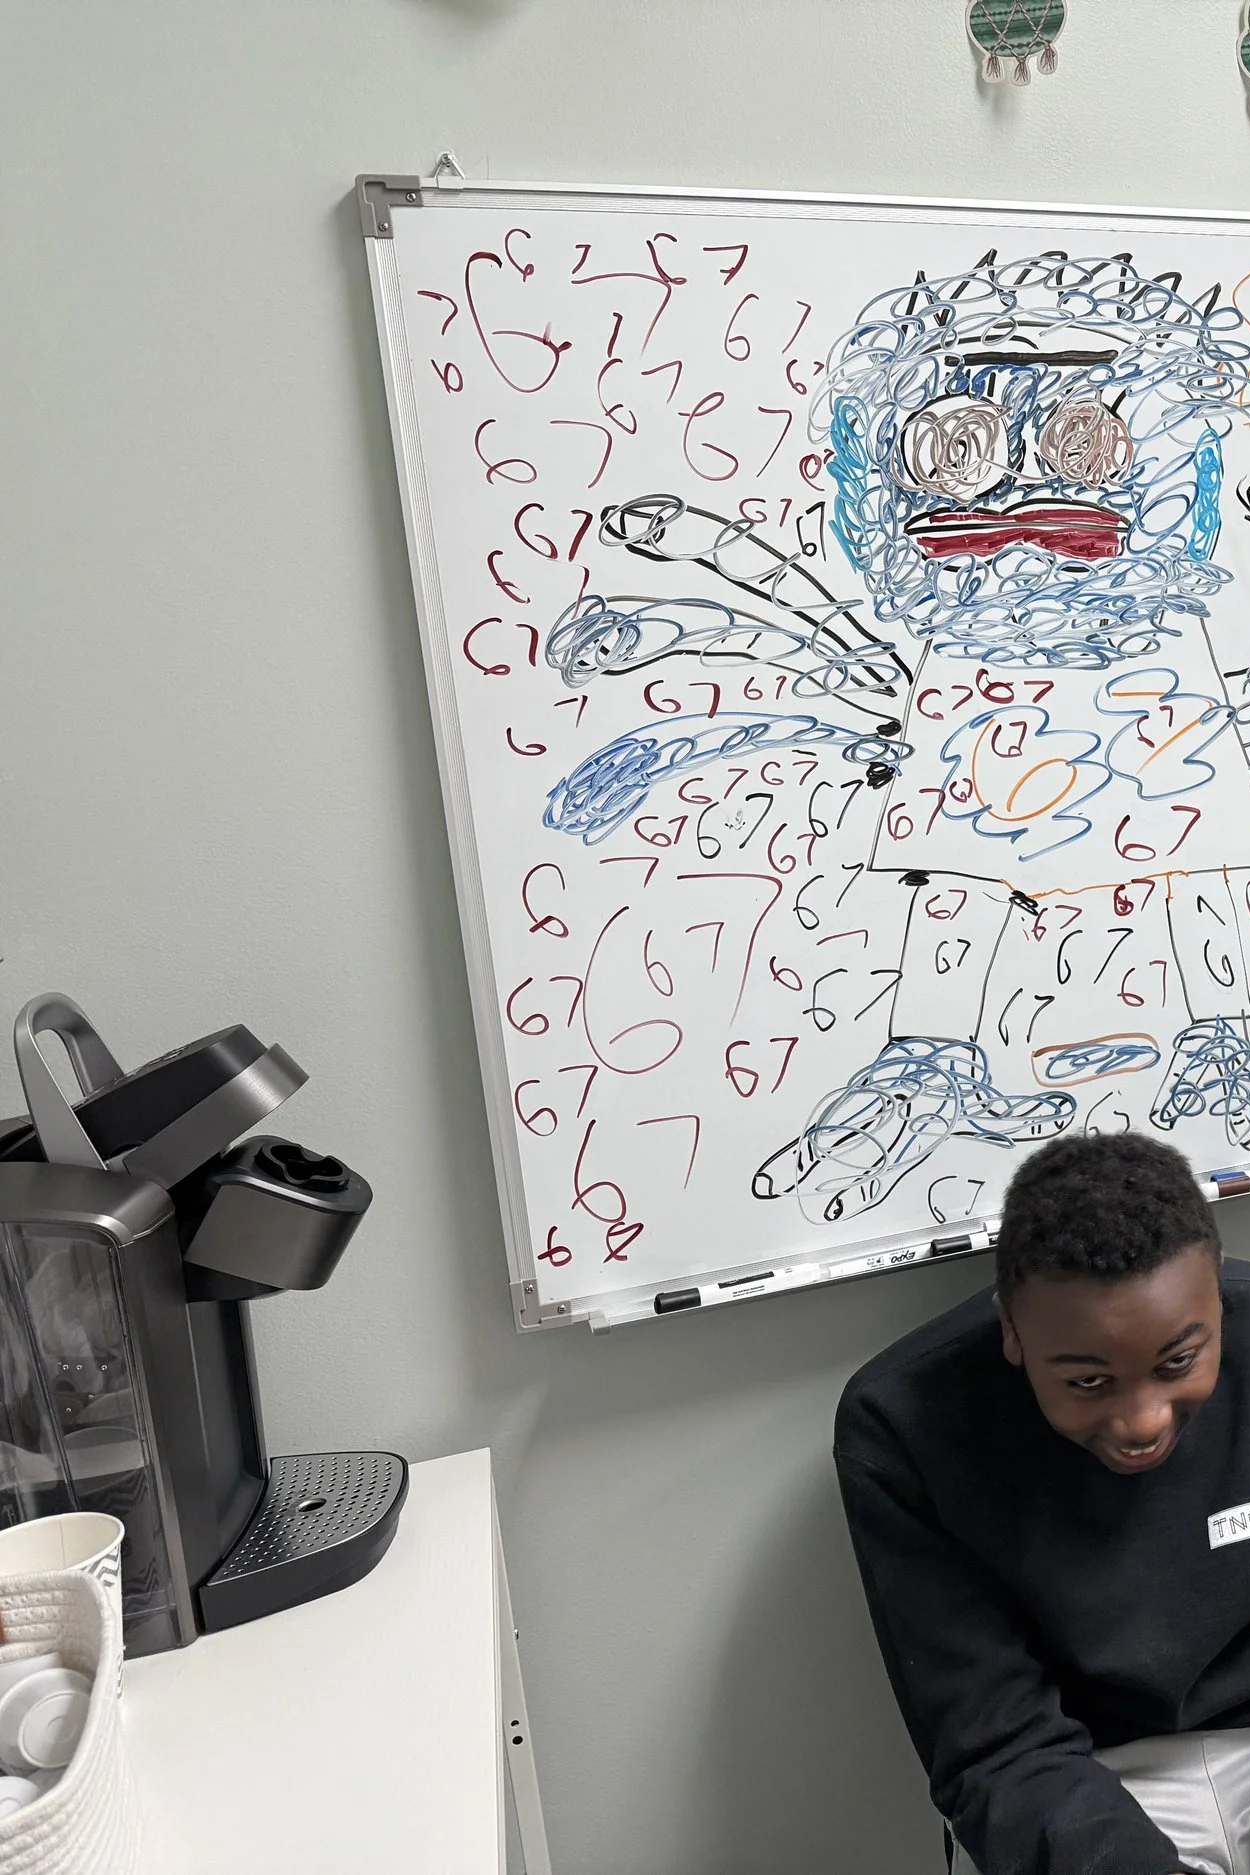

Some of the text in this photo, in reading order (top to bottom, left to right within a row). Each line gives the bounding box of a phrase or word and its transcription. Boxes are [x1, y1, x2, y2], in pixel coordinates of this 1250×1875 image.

[505, 228, 591, 281] 67
[647, 233, 748, 285] 67
[724, 294, 811, 361] 67
[597, 358, 682, 434] 67
[785, 359, 825, 395] 67
[475, 420, 612, 489] 67
[679, 391, 792, 481] 67
[514, 503, 593, 562] 67
[739, 498, 792, 527] 67
[797, 502, 826, 561] 67
[463, 617, 538, 675] 67
[644, 680, 720, 718] 67
[743, 677, 786, 700] 67
[917, 686, 973, 720] 67
[976, 669, 1053, 703] 67
[507, 695, 588, 756] 67
[992, 721, 1027, 757] 67
[1137, 706, 1172, 747] 67
[679, 768, 748, 804] 67
[760, 761, 818, 785] 67
[634, 816, 688, 846] 67
[697, 794, 773, 859] 67
[809, 780, 864, 837] 67
[888, 788, 944, 840] 67
[1115, 806, 1201, 861] 67
[768, 823, 816, 873] 67
[522, 858, 659, 938] 67
[794, 863, 864, 930] 67
[926, 889, 967, 920] 67
[1031, 905, 1082, 942] 67
[643, 922, 724, 996] 67
[936, 939, 971, 974] 67
[1057, 928, 1133, 985] 67
[507, 977, 583, 1035] 67
[802, 969, 903, 1031] 67
[1118, 960, 1167, 1007] 67
[726, 1037, 799, 1097] 67
[515, 1065, 598, 1136] 67
[572, 1115, 700, 1223] 67
[929, 1176, 985, 1223] 67
[890, 1250, 916, 1264] EXPO
